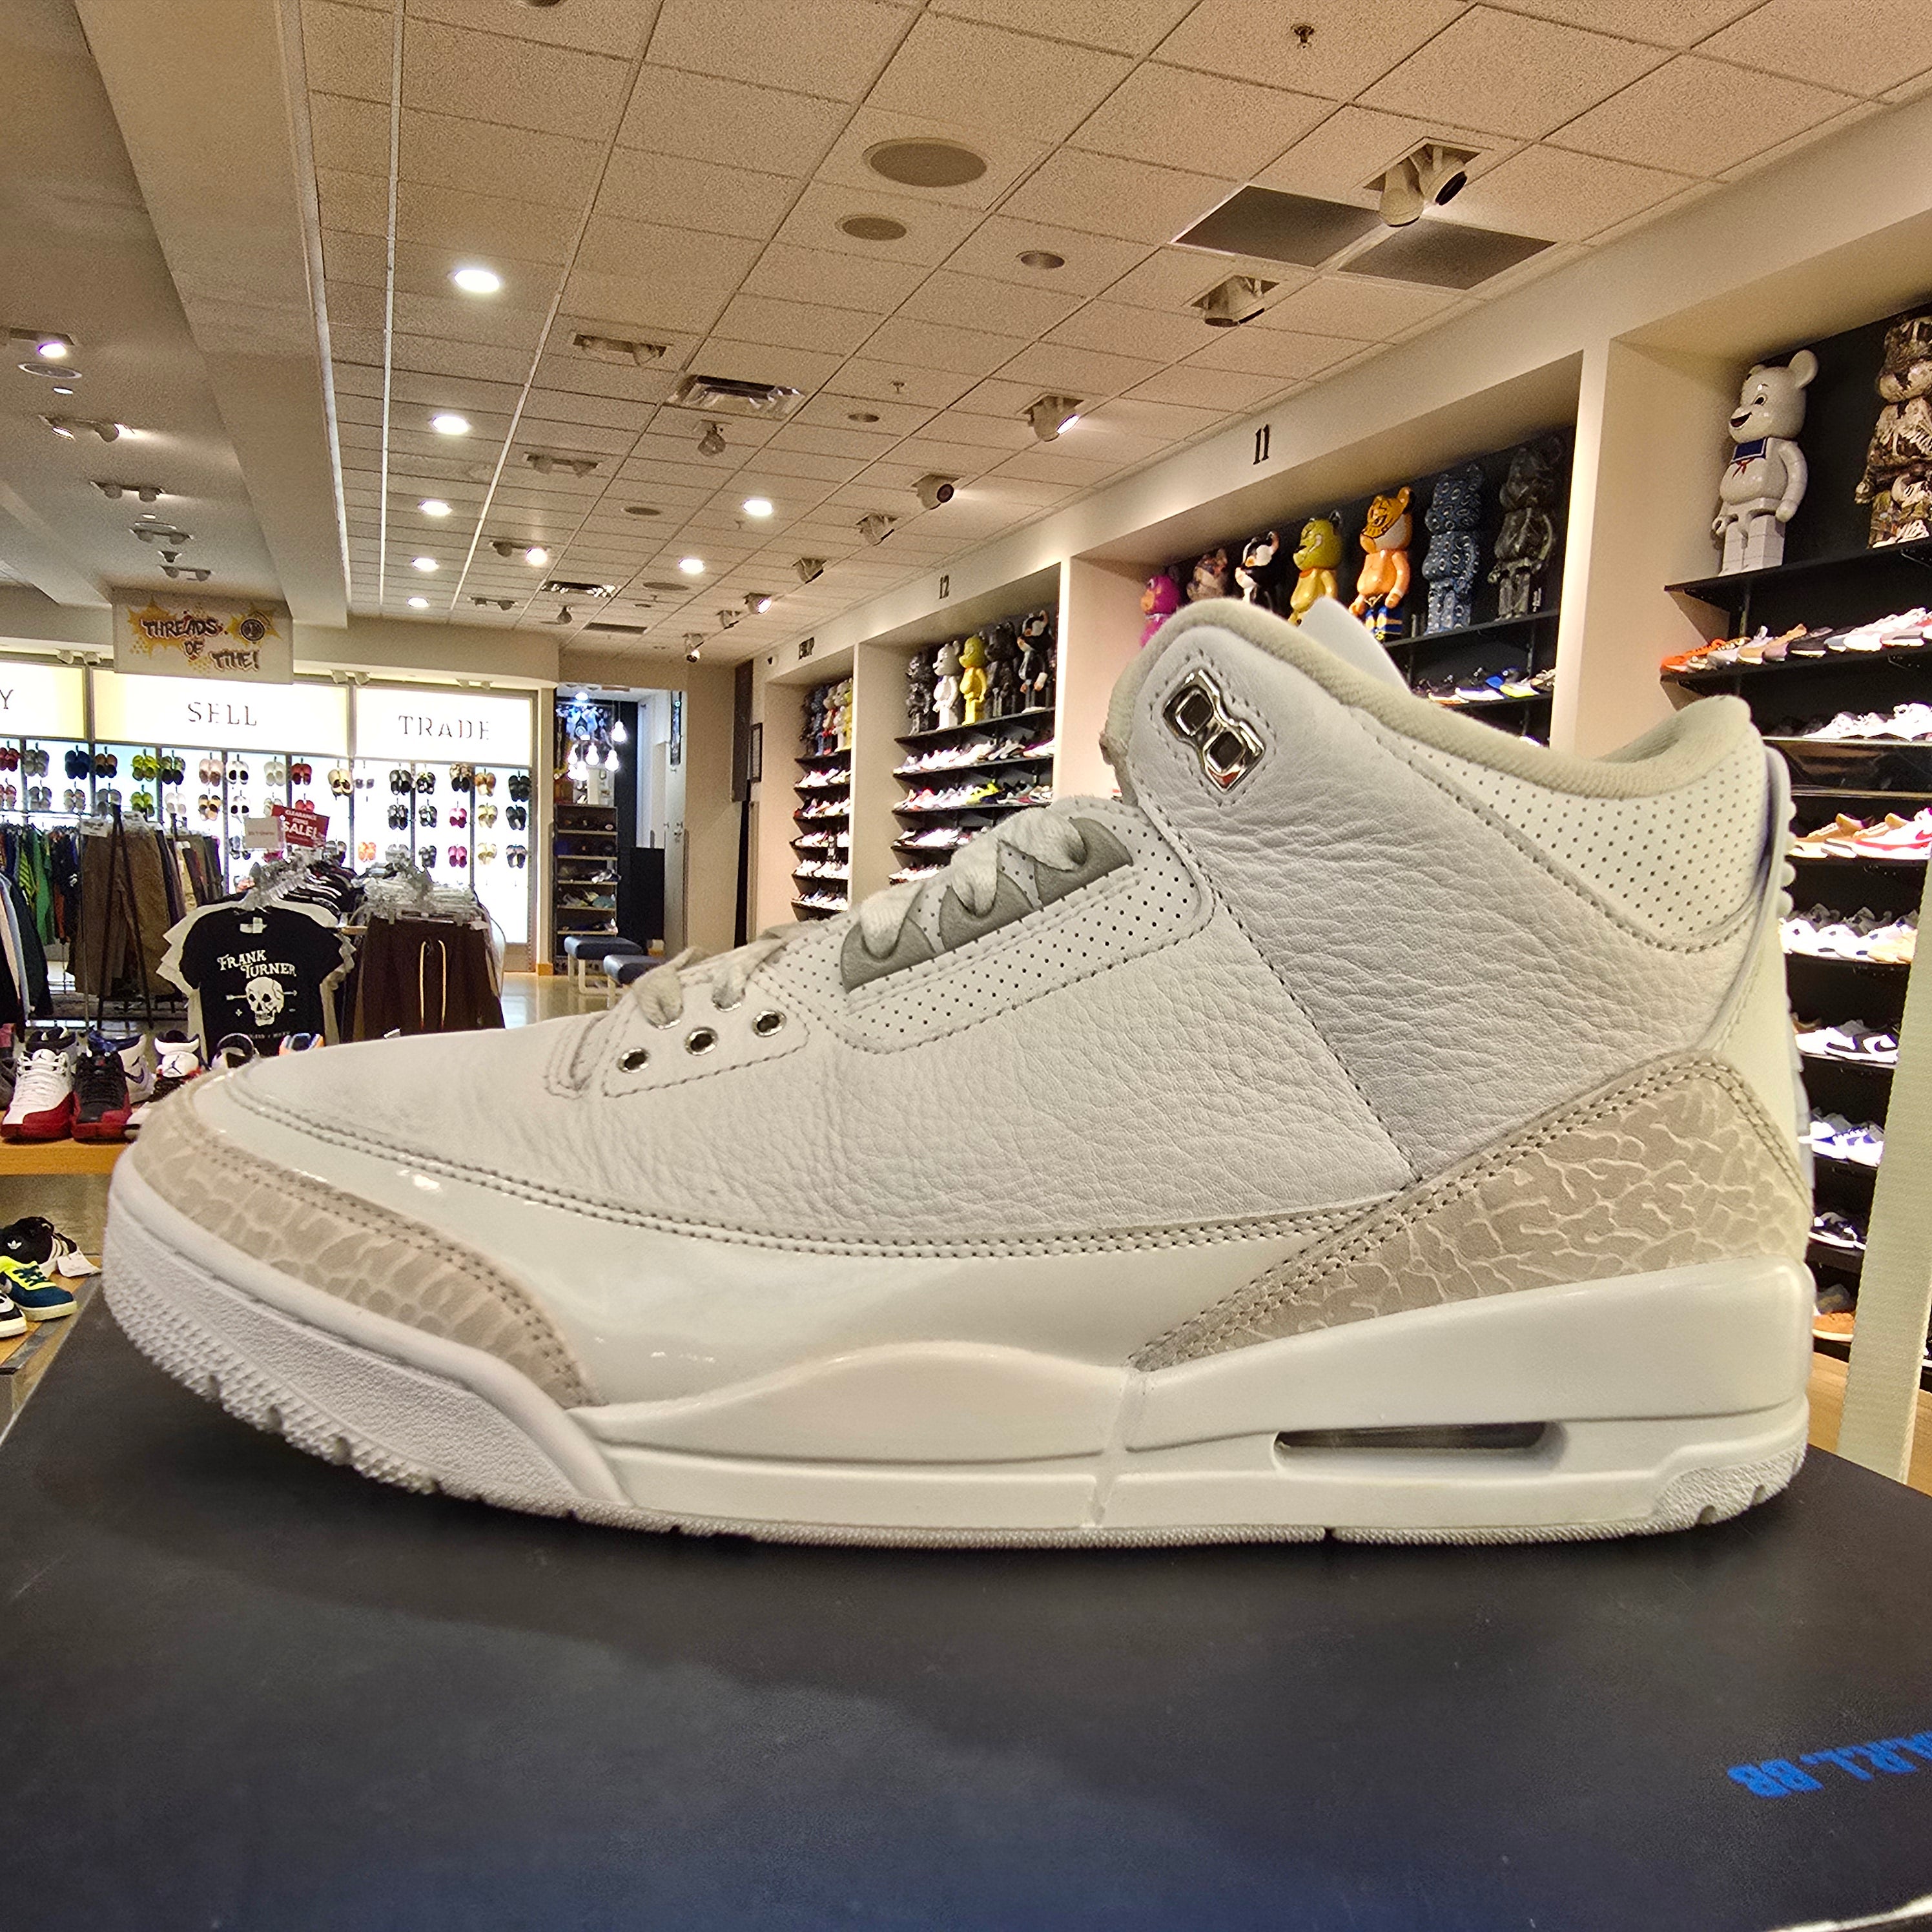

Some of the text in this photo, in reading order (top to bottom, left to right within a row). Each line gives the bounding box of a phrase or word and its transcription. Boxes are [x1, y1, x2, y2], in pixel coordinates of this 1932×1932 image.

[1253, 424, 1269, 466] 11
[939, 575, 950, 599] 12
[140, 617, 219, 638] THREADS
[184, 639, 204, 657] OF
[0, 689, 14, 710] Y
[187, 701, 257, 726] SELL
[398, 715, 489, 740] TRADE
[283, 821, 318, 839] SALE!
[216, 949, 267, 971] FRANK
[240, 961, 297, 979] TURNER
